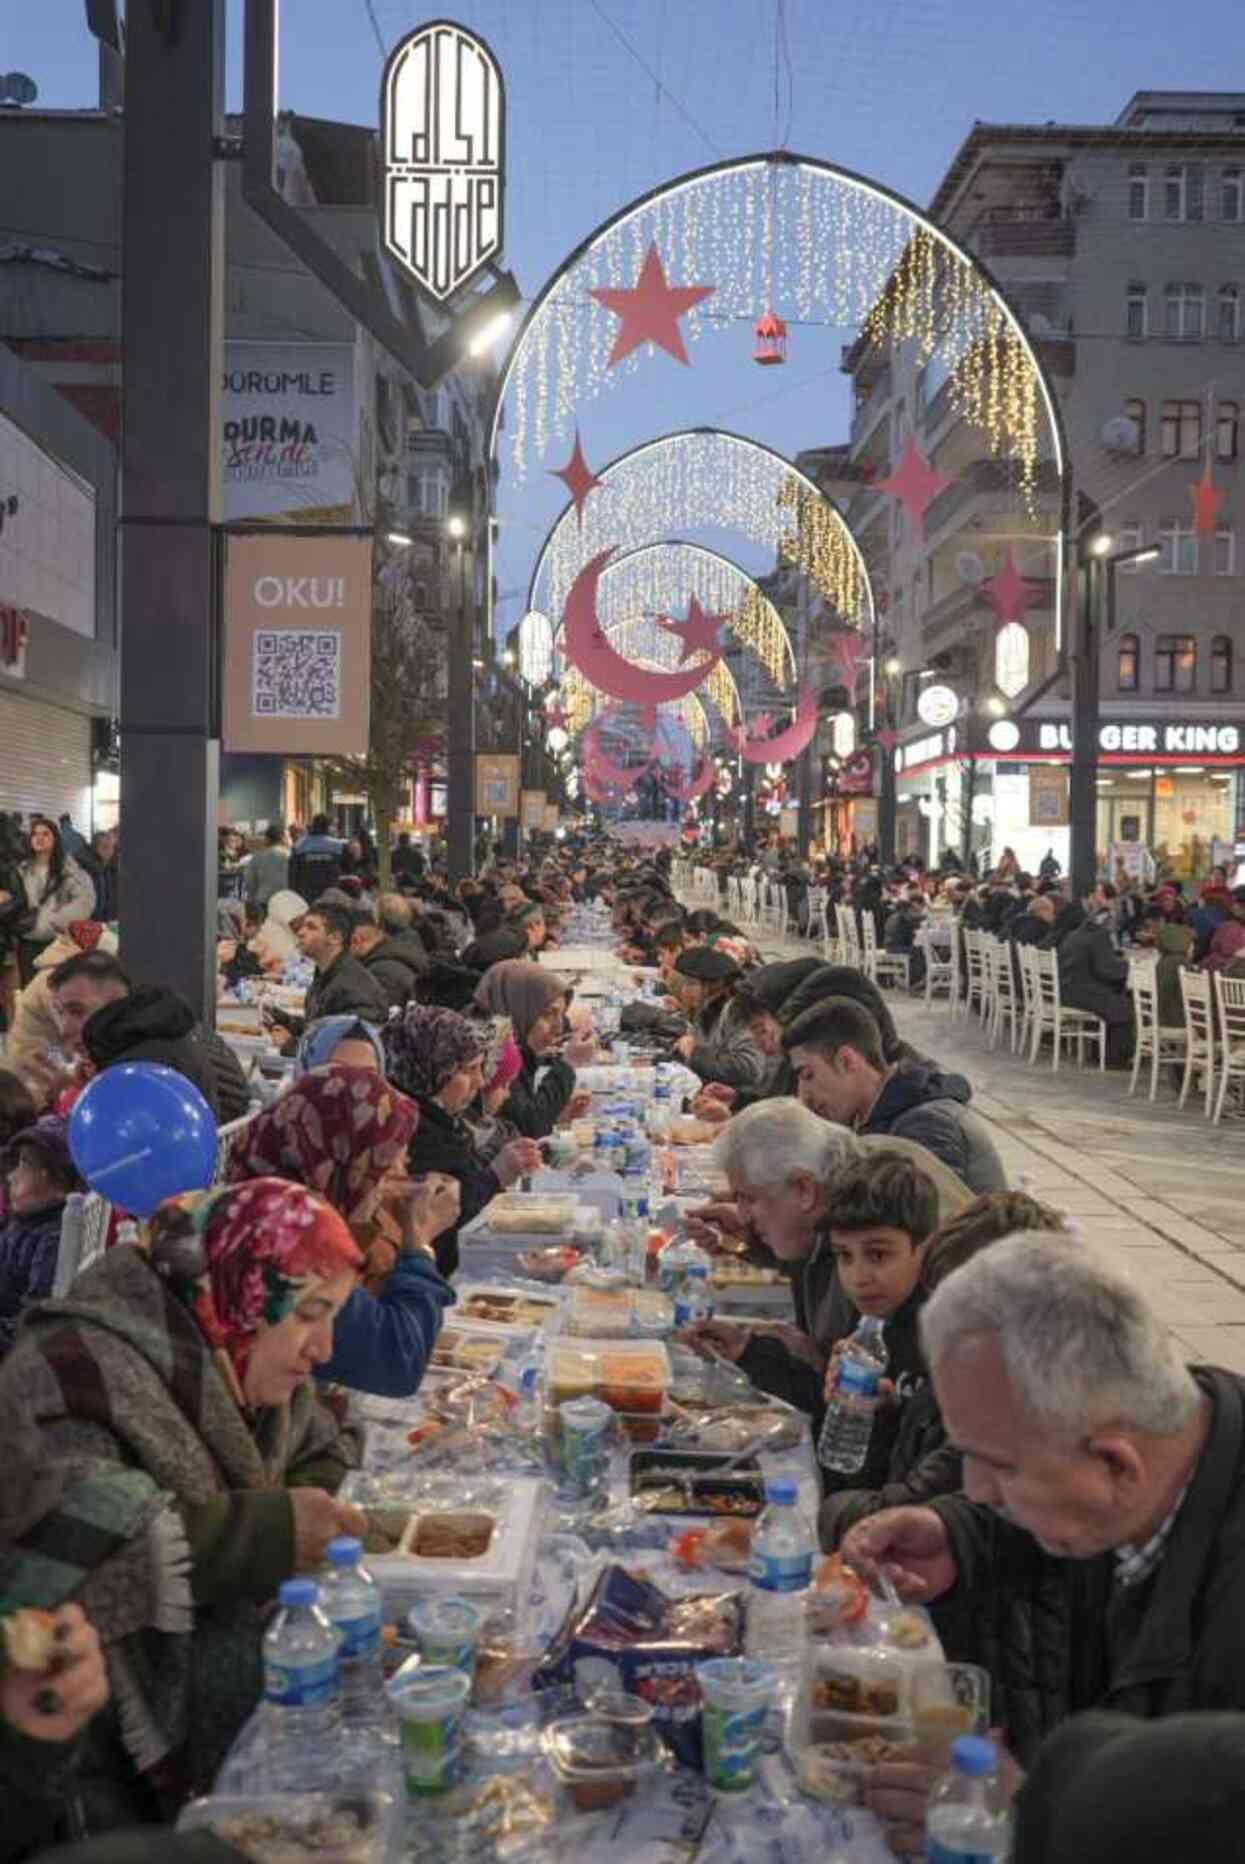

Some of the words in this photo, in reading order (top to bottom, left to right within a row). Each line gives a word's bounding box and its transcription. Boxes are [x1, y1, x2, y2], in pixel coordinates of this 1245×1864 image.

[254, 576, 344, 607] OKU!
[1040, 723, 1157, 751] BUGER
[1164, 724, 1240, 752] KING
